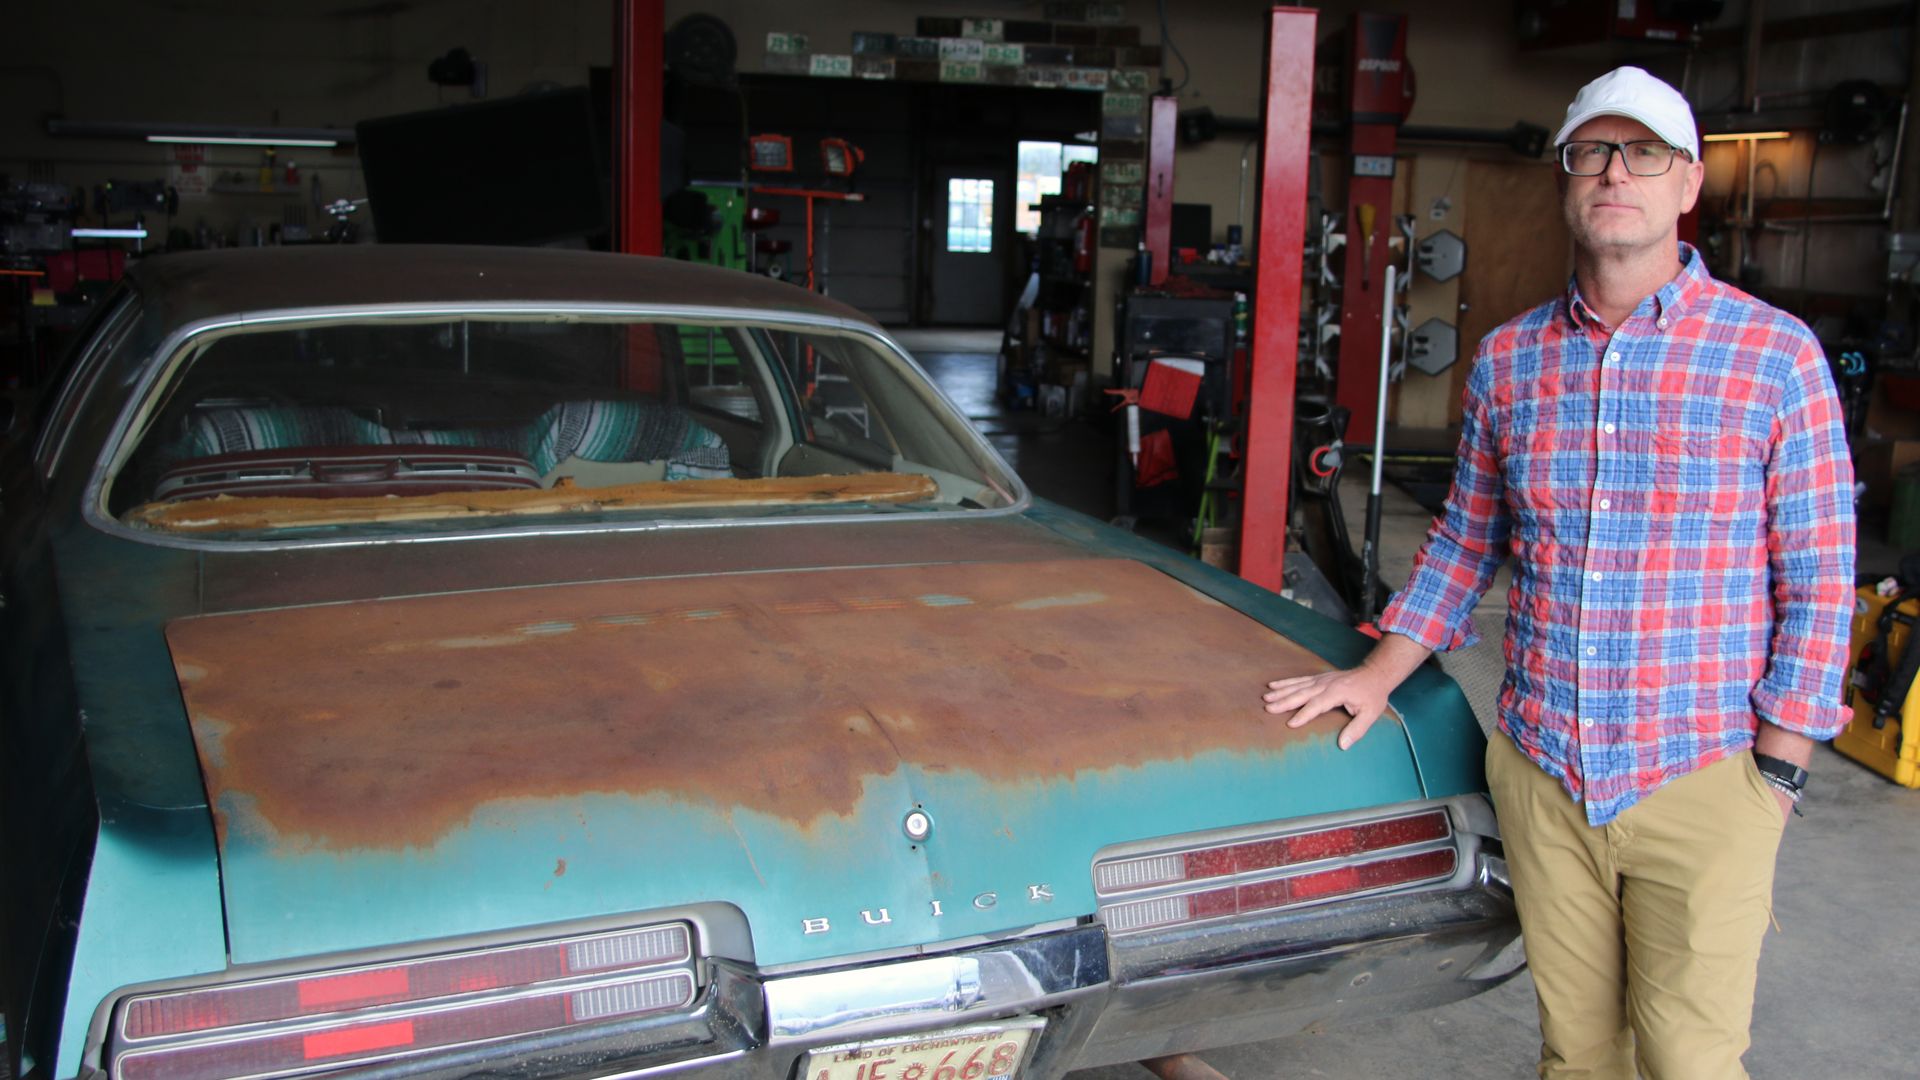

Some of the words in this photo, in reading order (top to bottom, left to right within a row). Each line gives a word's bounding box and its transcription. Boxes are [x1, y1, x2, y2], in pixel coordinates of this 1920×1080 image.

[802, 883, 1055, 935] BUICK
[834, 1050, 873, 1063] LAND
[878, 1046, 897, 1056] OF
[902, 1031, 1004, 1053] ENCHANTMENT
[932, 1041, 1018, 1080] 668
